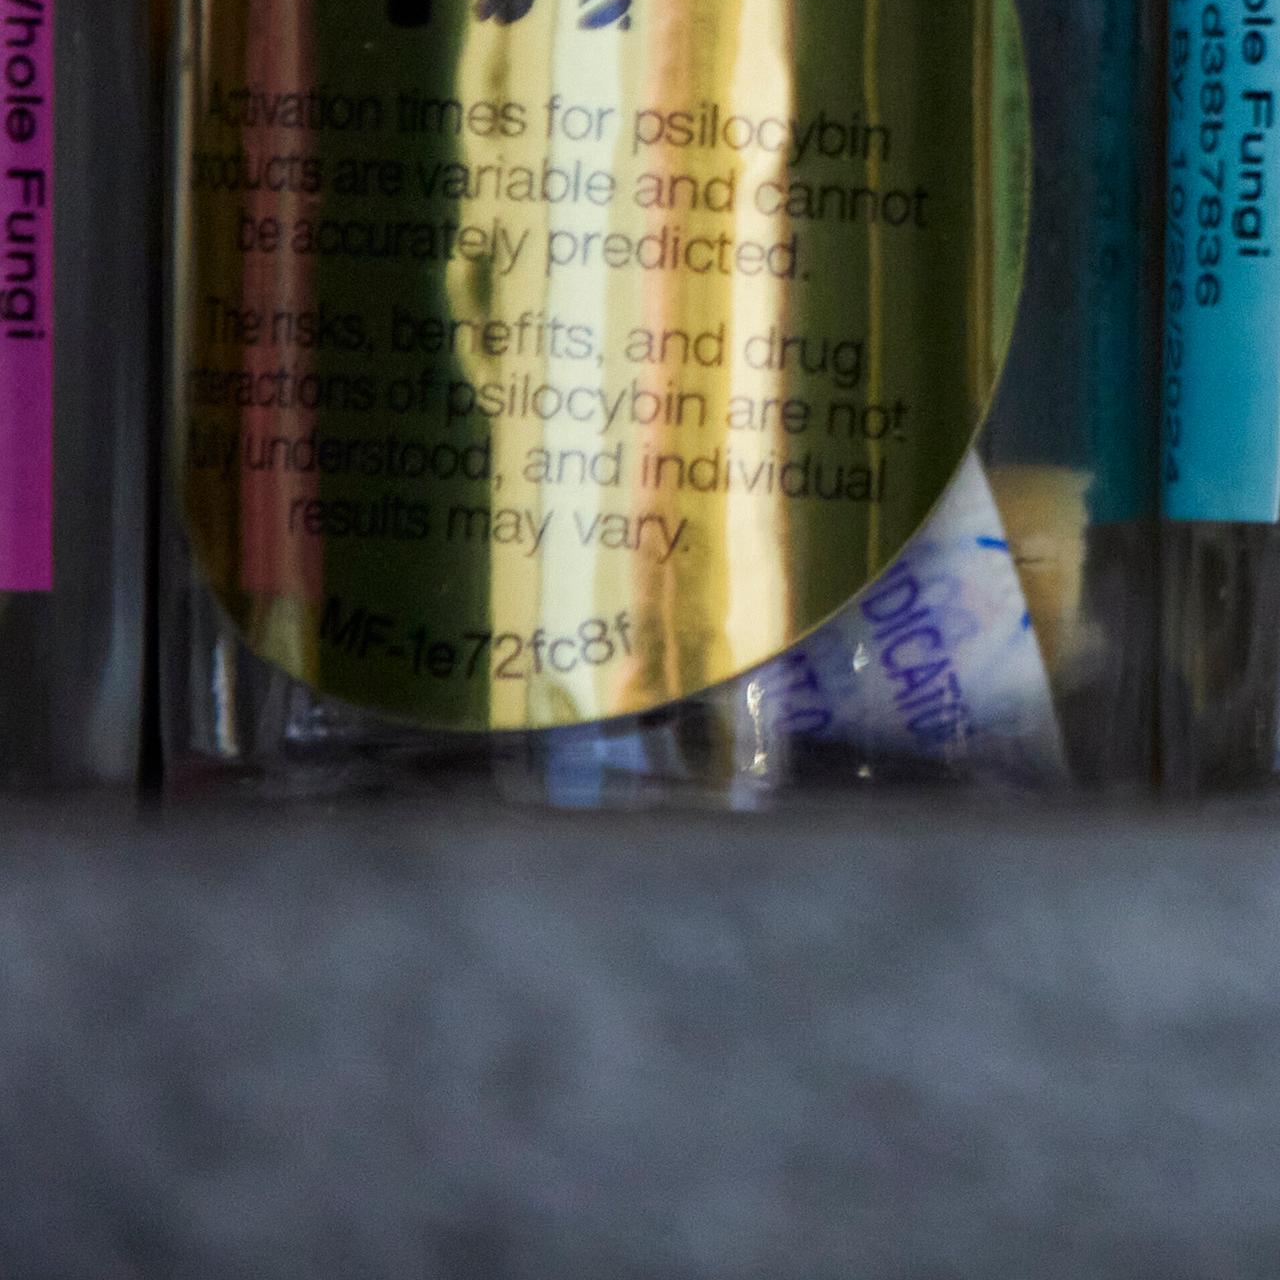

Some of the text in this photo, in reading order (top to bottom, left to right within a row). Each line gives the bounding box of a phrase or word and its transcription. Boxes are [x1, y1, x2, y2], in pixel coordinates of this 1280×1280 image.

[399, 90, 528, 139] times
[544, 94, 615, 142] for
[631, 99, 893, 164] psilocybin
[1194, 2, 1228, 309] d38b7836
[333, 163, 406, 198] are
[417, 157, 617, 208] variable
[633, 165, 734, 212] and
[752, 176, 930, 230] cannot
[1230, 89, 1274, 259] Fungi
[0, 167, 46, 340] Fungi
[238, 208, 811, 282] be accurately predicted.
[206, 294, 262, 346] The
[391, 303, 606, 367] benefits,
[624, 322, 726, 364] and
[743, 326, 866, 389] drug
[385, 368, 436, 415] of
[444, 373, 706, 436] psilocybin
[727, 396, 810, 436] are
[828, 396, 910, 442] not
[243, 424, 503, 490] understood,
[522, 438, 622, 487] and
[640, 446, 888, 503] individual
[286, 493, 690, 566] results may vary.
